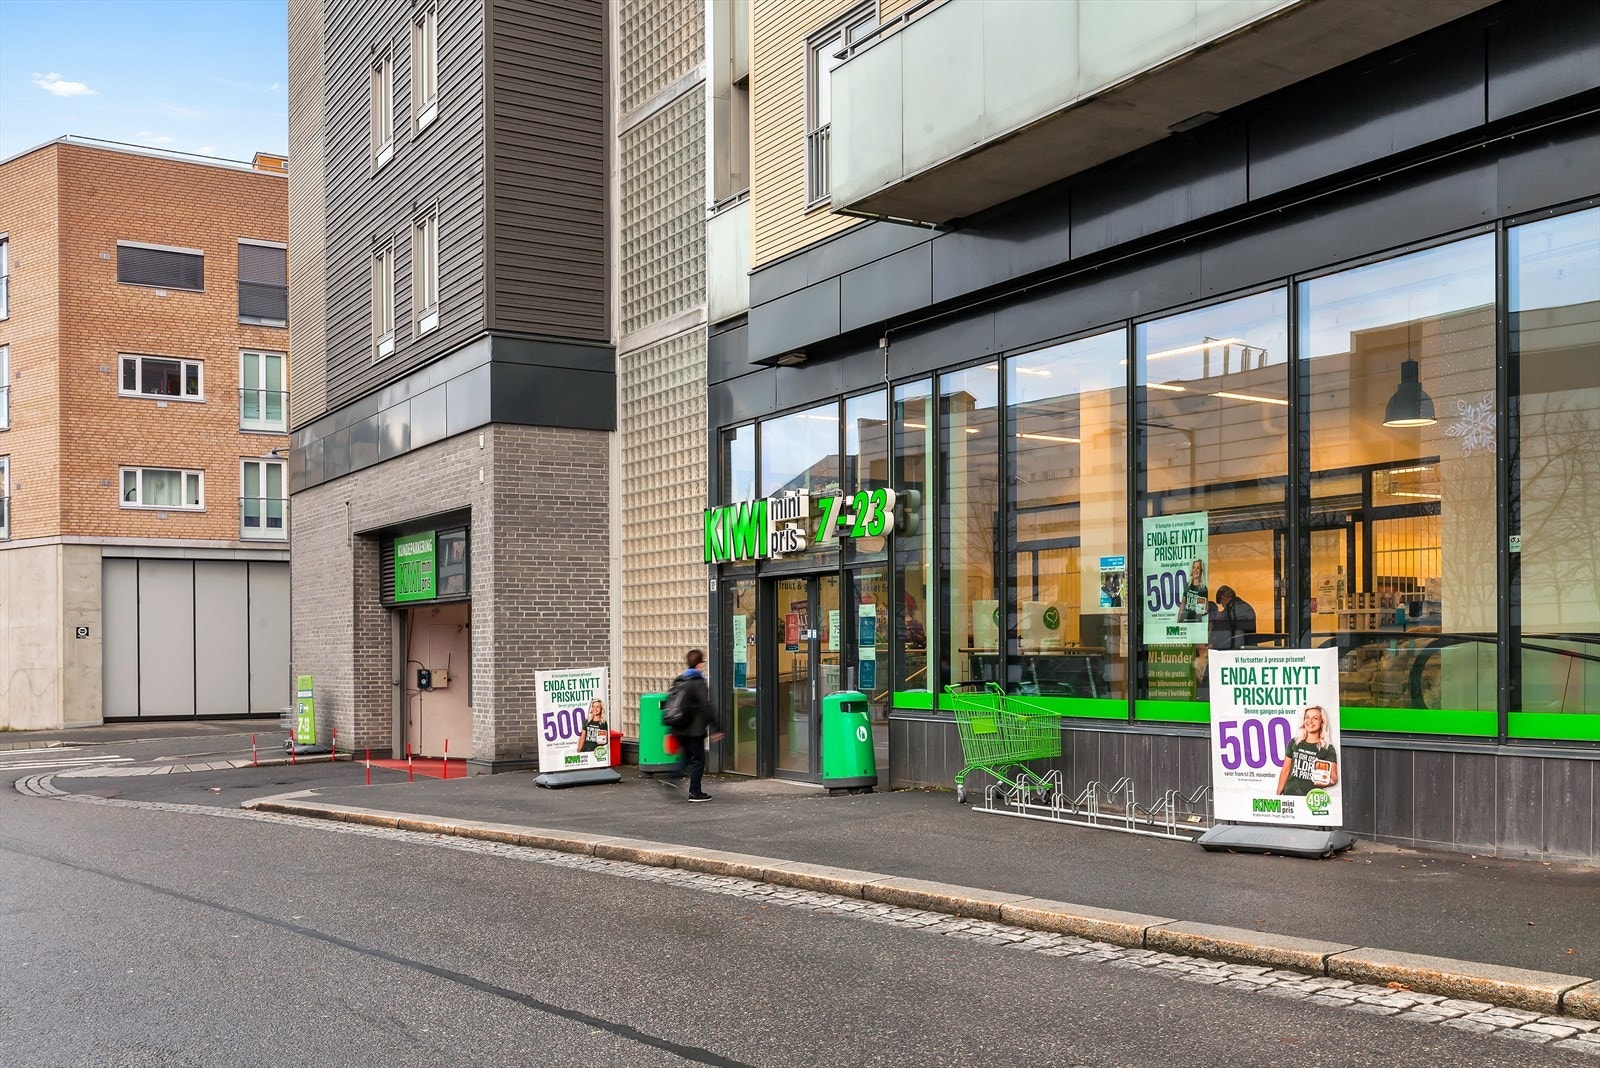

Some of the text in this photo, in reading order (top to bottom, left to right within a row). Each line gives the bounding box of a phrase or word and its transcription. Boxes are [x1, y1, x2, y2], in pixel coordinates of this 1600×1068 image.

[814, 487, 888, 543] 7-23
[704, 488, 801, 564] KIWI mini
[771, 523, 798, 554] pris
[1147, 528, 1204, 547] ENDA ET NYTT
[1154, 545, 1196, 562] PRISKUTT!
[778, 580, 796, 590] frukt
[797, 581, 802, 590] &
[1146, 568, 1188, 613] 500
[543, 677, 600, 692] ENDA ET NYTT
[1221, 666, 1320, 685] ENDA ET NYTT
[551, 689, 594, 703] PRISKUTT!
[1233, 687, 1307, 705] PRISKUTT!
[542, 707, 585, 742] 500
[1219, 717, 1291, 770] 500
[1253, 798, 1281, 813] KIWI
